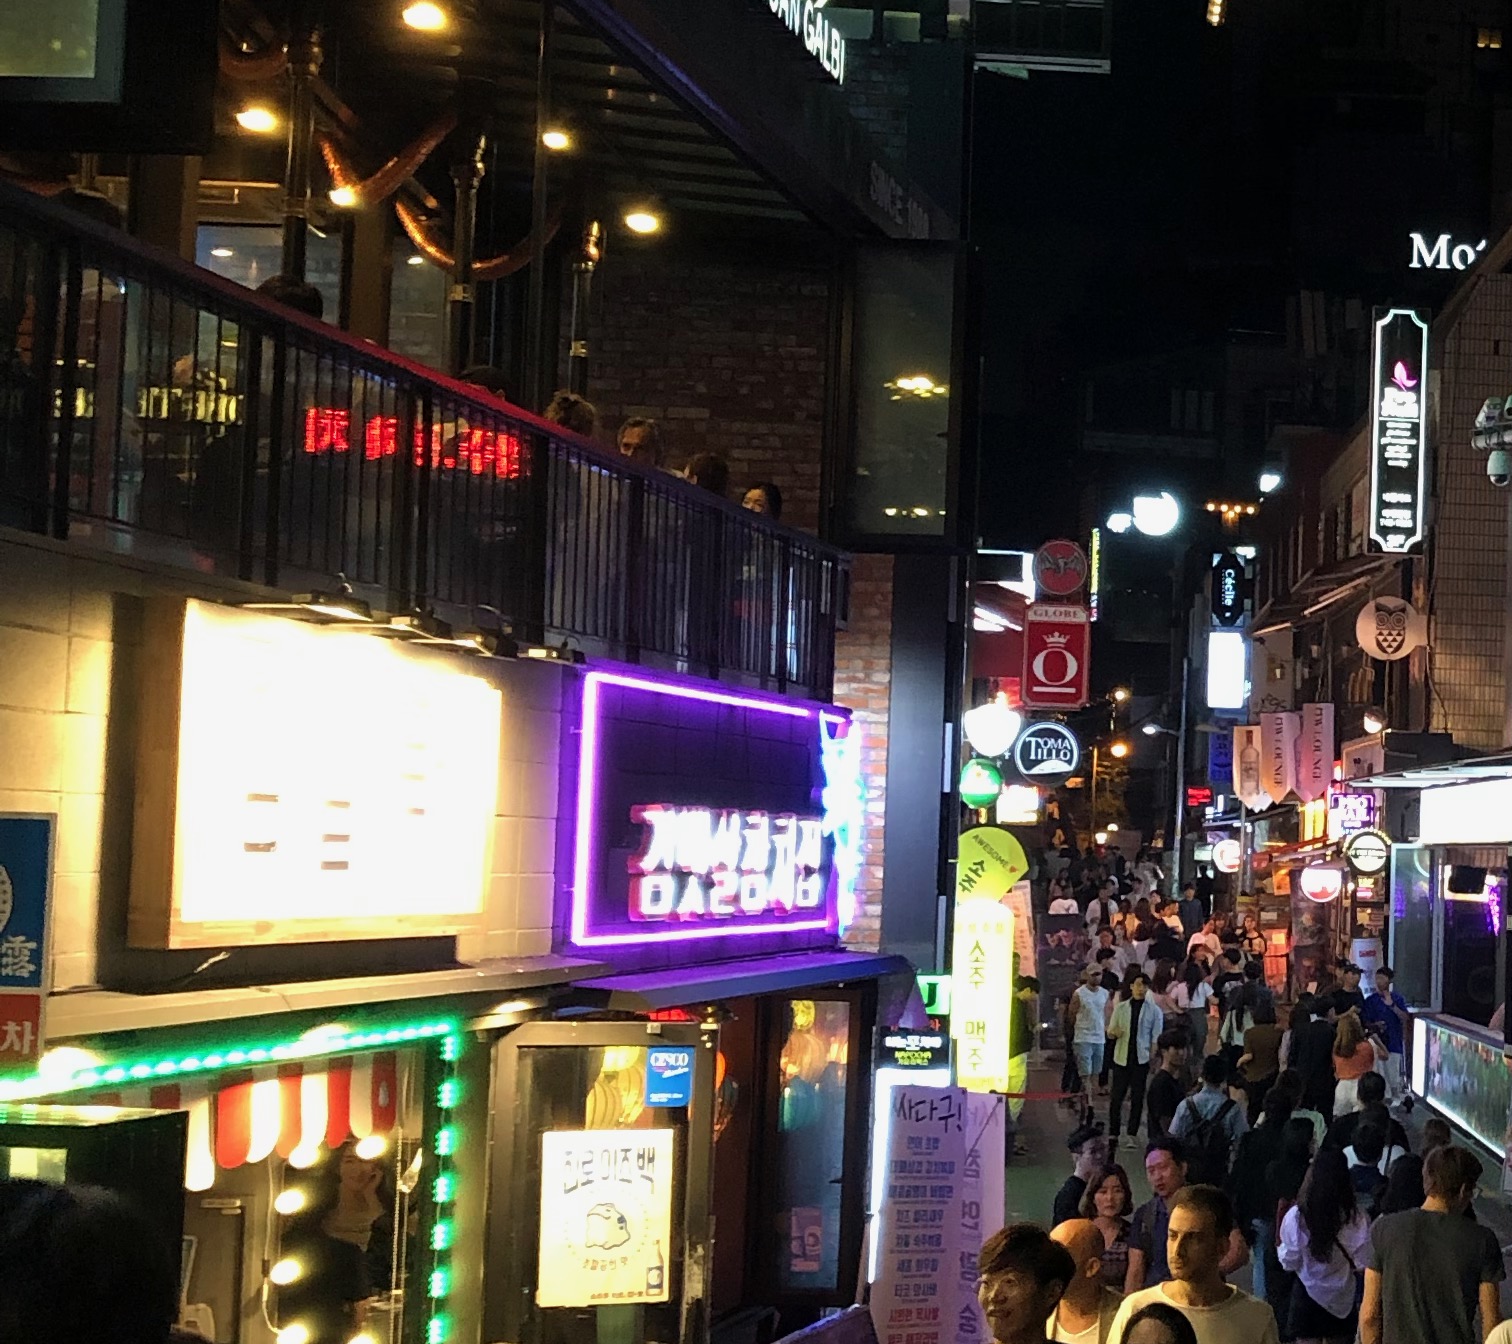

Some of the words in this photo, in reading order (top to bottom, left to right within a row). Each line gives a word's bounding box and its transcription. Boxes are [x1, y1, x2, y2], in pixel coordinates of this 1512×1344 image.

[803, 0, 847, 86] GALBI
[1409, 233, 1487, 270] Mo
[1033, 608, 1080, 619] GLOBE
[971, 833, 1010, 870] AWESOME
[968, 939, 986, 990] 소주
[964, 1021, 987, 1071] 맥주
